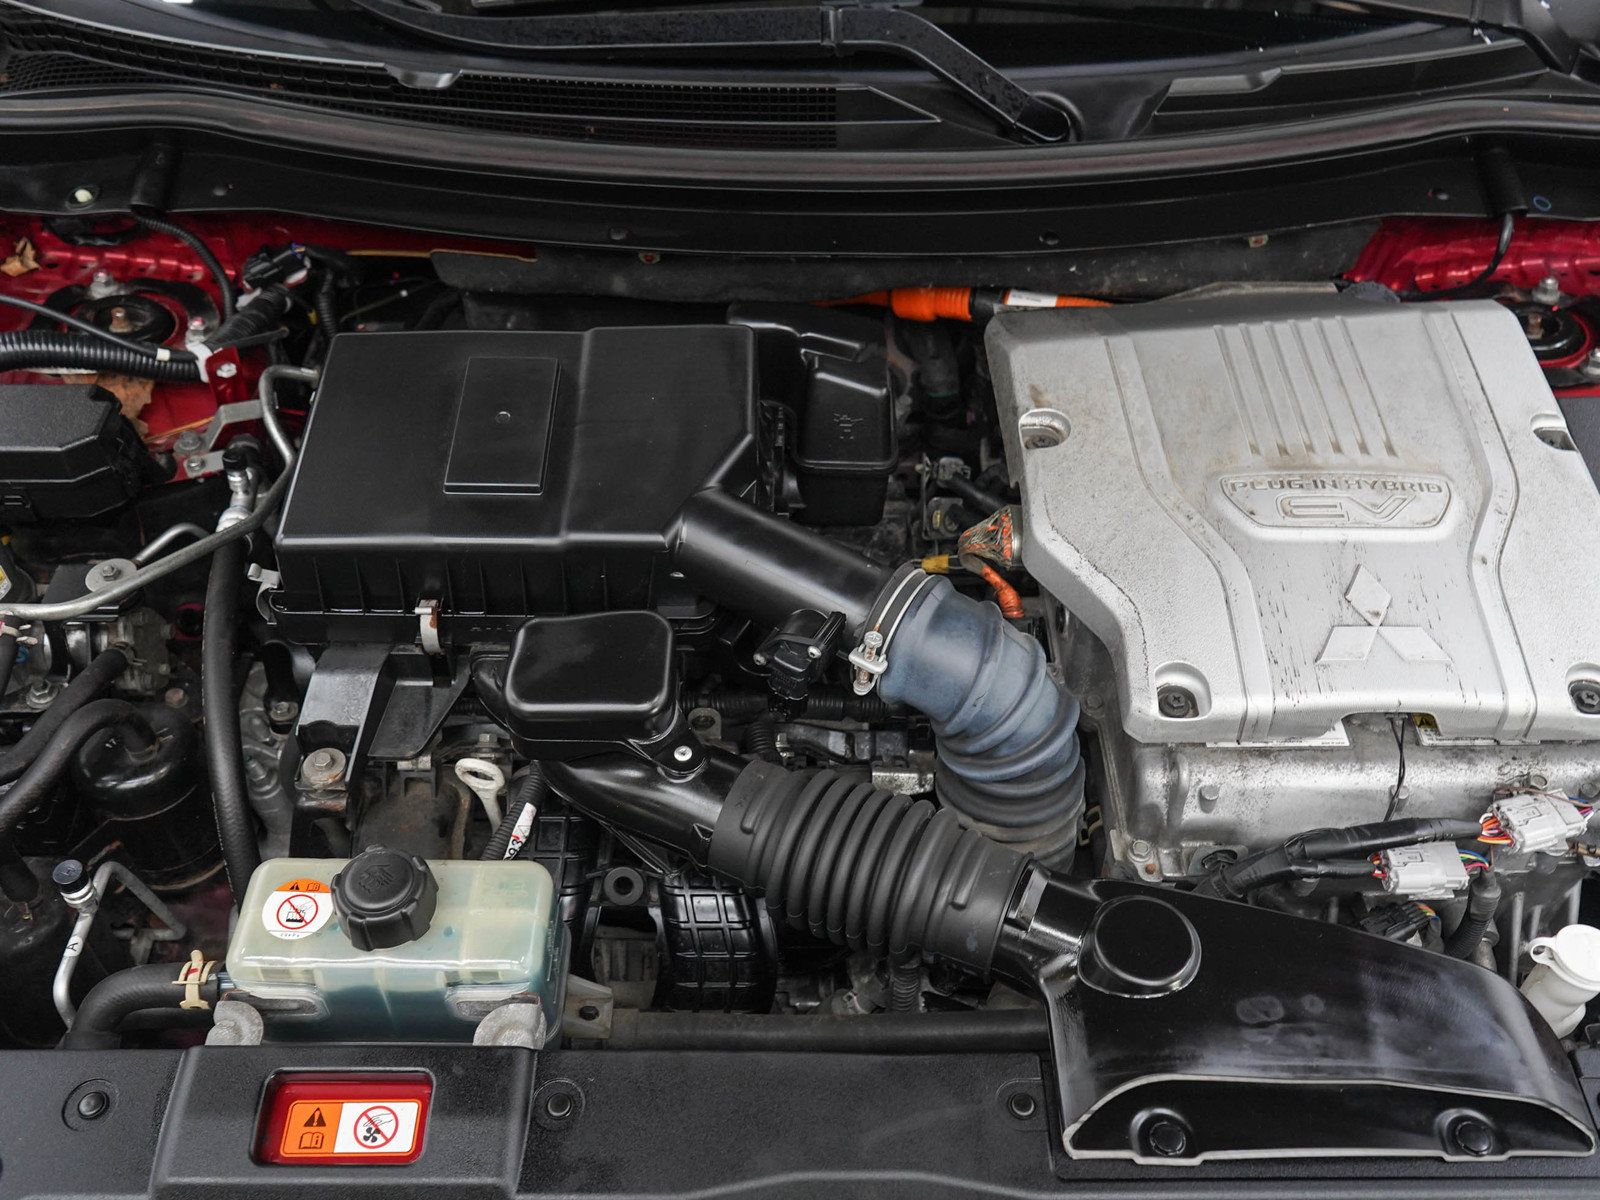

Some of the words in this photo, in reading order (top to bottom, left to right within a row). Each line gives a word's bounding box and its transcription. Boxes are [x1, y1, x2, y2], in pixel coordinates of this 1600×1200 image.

[1231, 479, 1338, 493] PLUG-IN
[1343, 480, 1443, 494] HYBRID
[1276, 493, 1416, 524] EV
